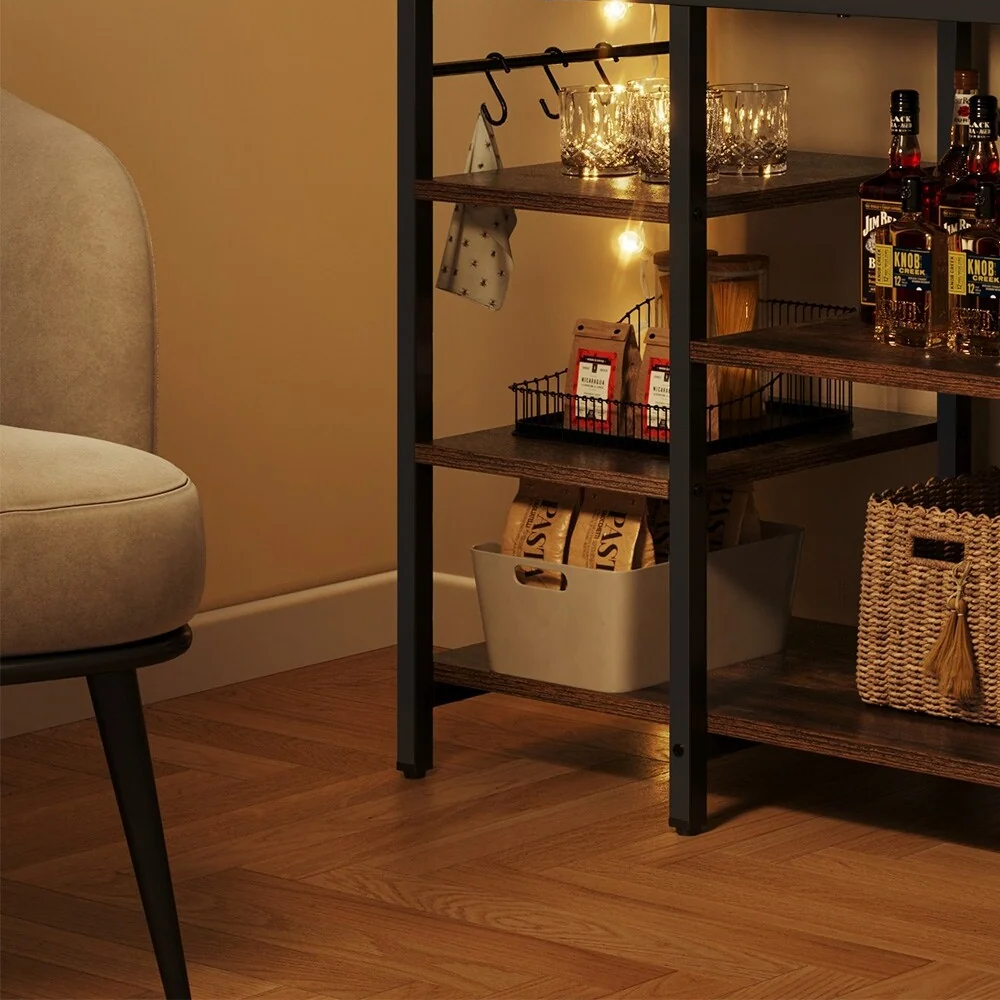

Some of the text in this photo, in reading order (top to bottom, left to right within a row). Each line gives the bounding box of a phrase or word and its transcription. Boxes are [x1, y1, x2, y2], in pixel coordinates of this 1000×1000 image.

[863, 214, 880, 237] JIM
[894, 251, 921, 269] KNOB
[968, 258, 995, 276] KNOB
[898, 267, 926, 276] CREEK
[972, 274, 1000, 283] CREEK
[894, 275, 901, 287] 12
[968, 283, 975, 294] 12
[596, 510, 627, 571] PAST
